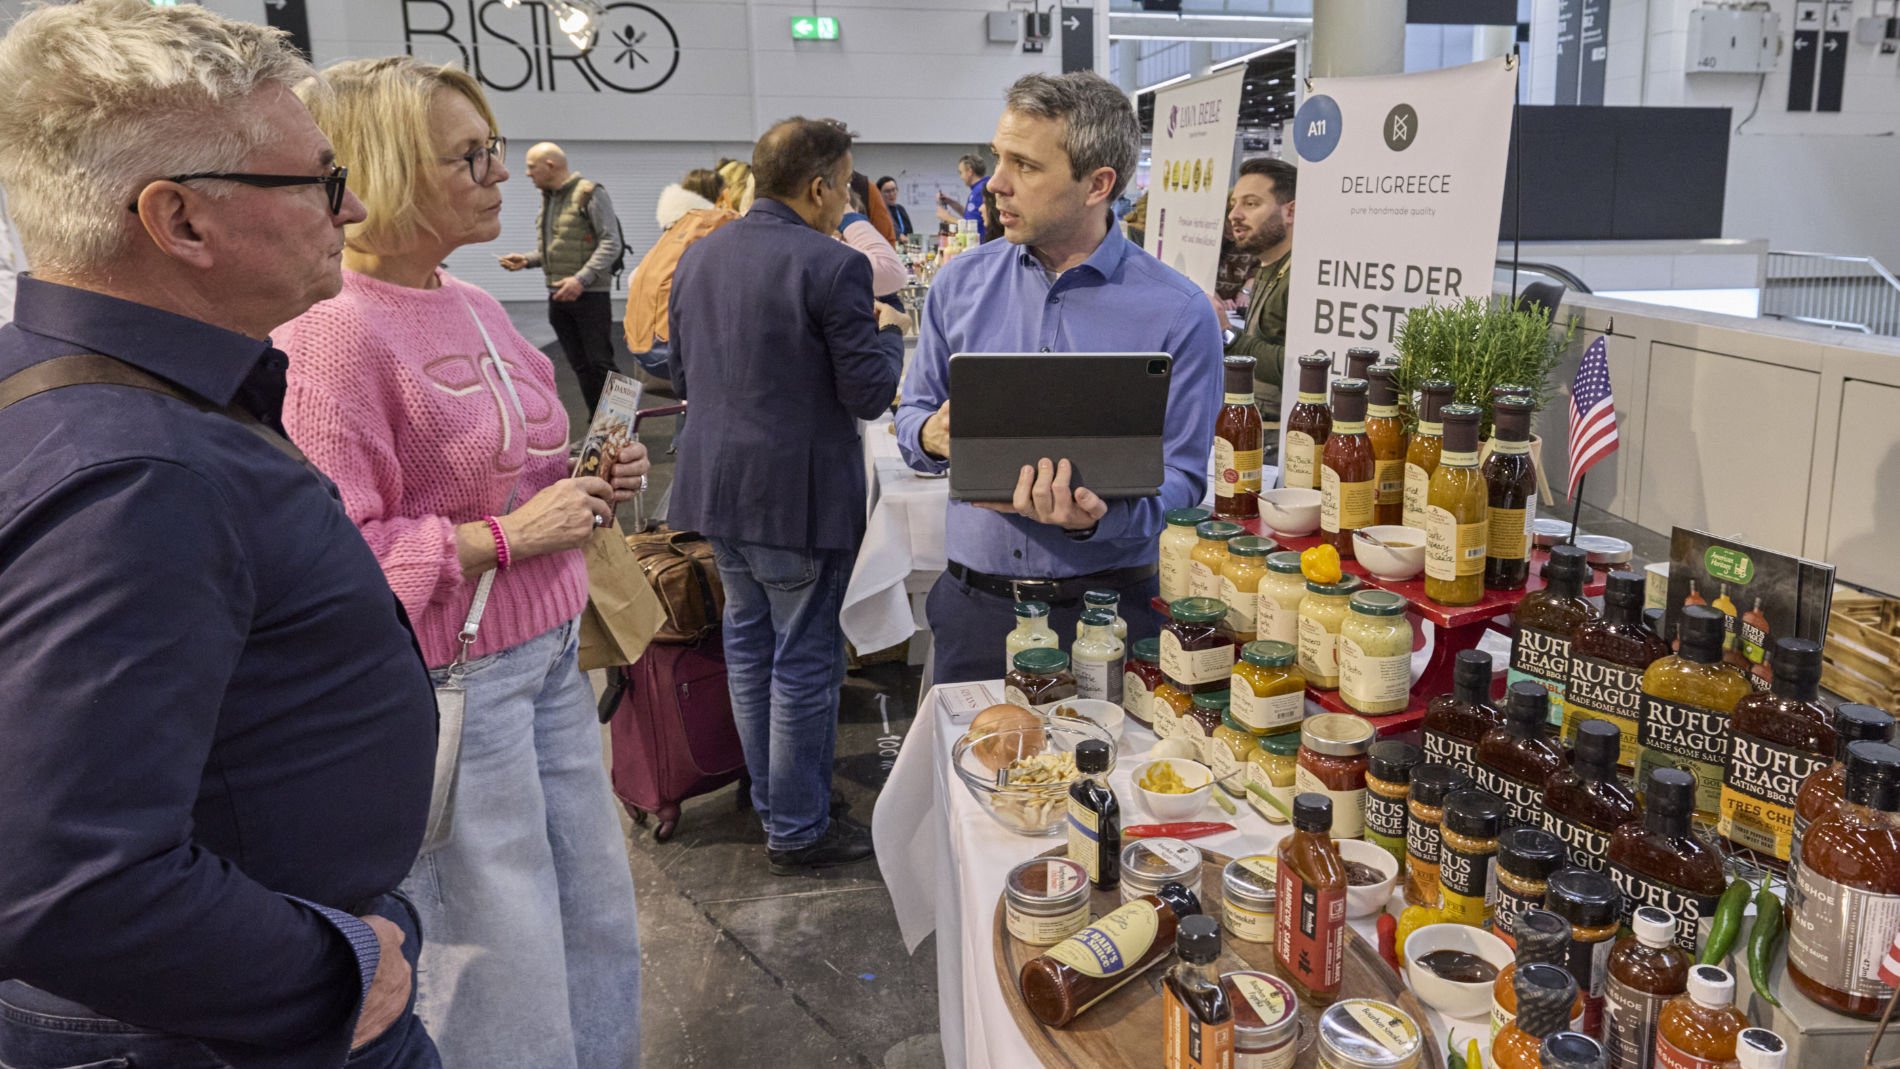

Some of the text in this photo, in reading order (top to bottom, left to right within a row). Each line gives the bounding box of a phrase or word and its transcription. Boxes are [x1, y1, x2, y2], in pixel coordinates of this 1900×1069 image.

[402, 0, 680, 93] BISTRO
[1307, 120, 1327, 137] A11
[1341, 174, 1452, 194] DELIGREECE
[1350, 204, 1436, 217] pure handmade quality
[1317, 259, 1463, 297] EINES DER
[1314, 298, 1421, 344] BEST
[1743, 622, 1766, 638] RUFUS
[1517, 661, 1545, 676] LATINO
[1571, 658, 1644, 694] RUFUS
[1569, 694, 1591, 706] MADE
[1592, 701, 1615, 713] SOME
[1647, 701, 1730, 737] RUFUS
[876, 735, 902, 758] 100
[1646, 738, 1672, 752] MADE
[1674, 746, 1700, 759] SOME
[1476, 766, 1544, 810] RUFUS
[1730, 776, 1764, 796] LATINO
[1766, 789, 1786, 802] BBQ
[1728, 798, 1762, 817] TRES
[1766, 810, 1792, 827] CHI
[1283, 876, 1293, 930] BARBECUE
[1610, 866, 1699, 920] RUFUS
[1090, 929, 1119, 964] BAIN'S
[1281, 929, 1292, 964] SAUCE
[1361, 1007, 1385, 1029] Bourbon
